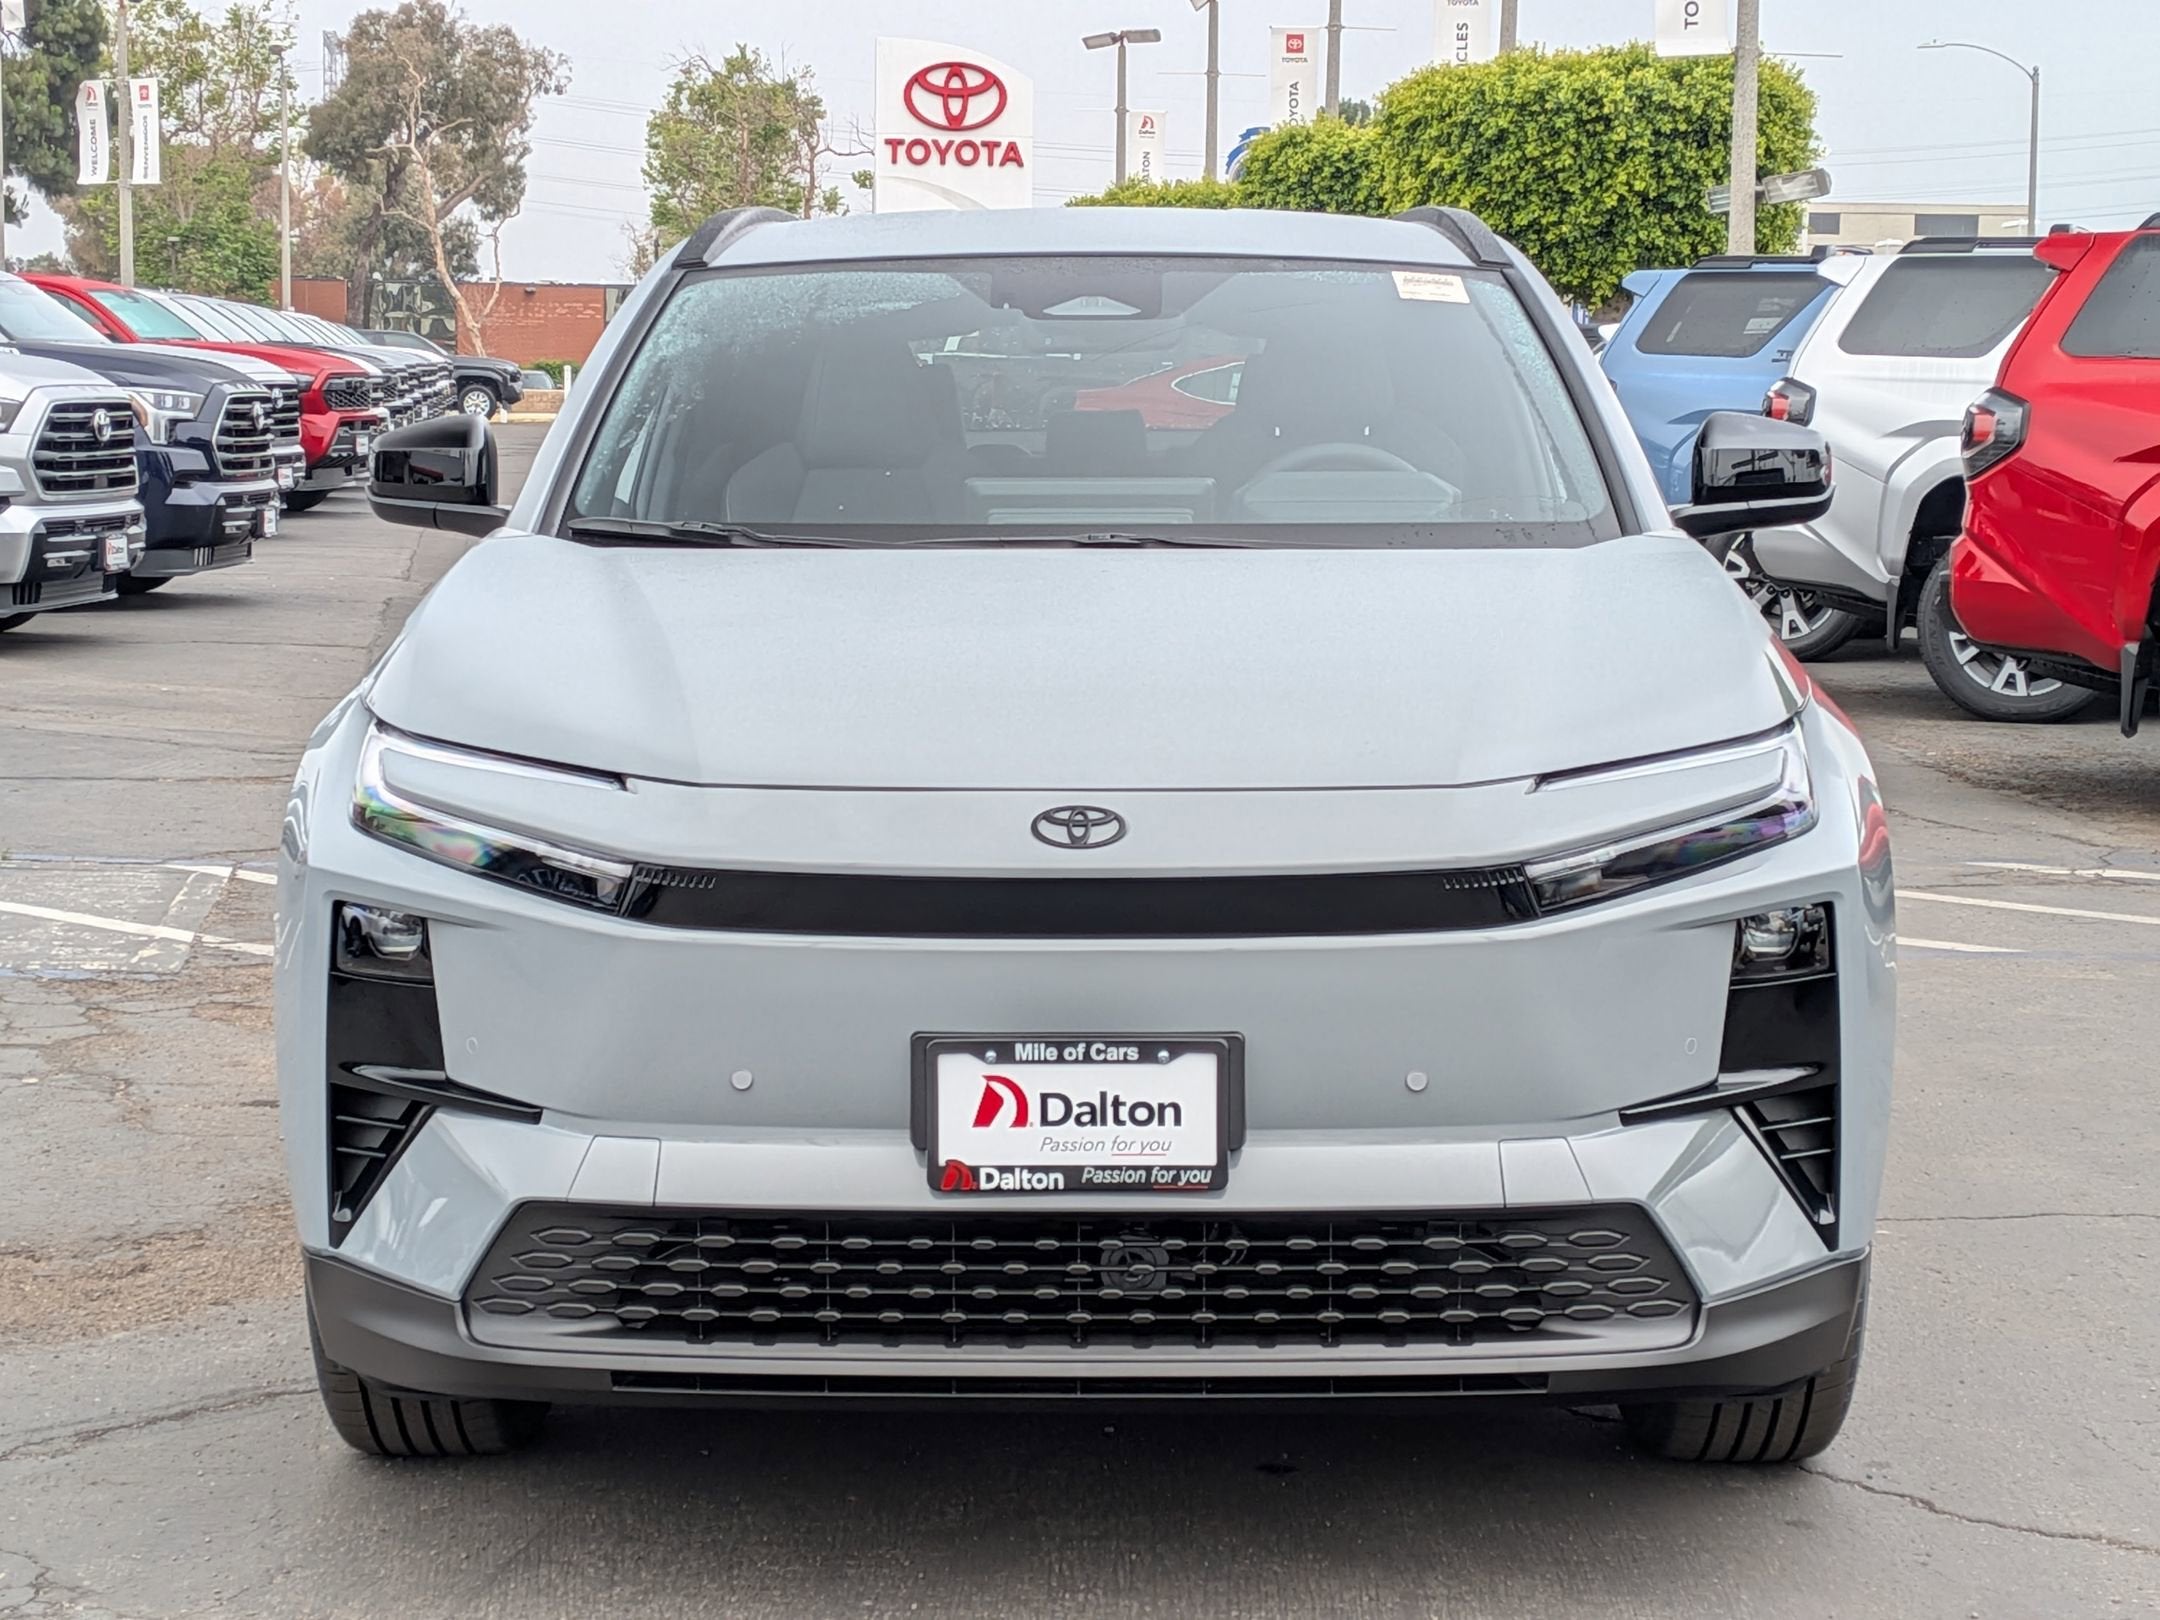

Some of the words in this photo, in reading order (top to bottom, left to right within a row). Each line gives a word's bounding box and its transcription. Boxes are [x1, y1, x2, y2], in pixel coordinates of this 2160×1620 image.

[89, 118, 98, 177] WELCOME
[884, 138, 1024, 167] TOYOTA
[1014, 1043, 1058, 1061] Mile
[1063, 1043, 1086, 1061] of
[1089, 1043, 1139, 1061] Cars
[1039, 1091, 1182, 1127] Dalton
[1040, 1136, 1106, 1152] Passion
[1110, 1135, 1138, 1153] for
[1139, 1140, 1172, 1155] you
[979, 1166, 1064, 1190] Dalton
[1081, 1166, 1146, 1184] Passion
[1150, 1166, 1178, 1184] for
[1177, 1168, 1212, 1186] you
